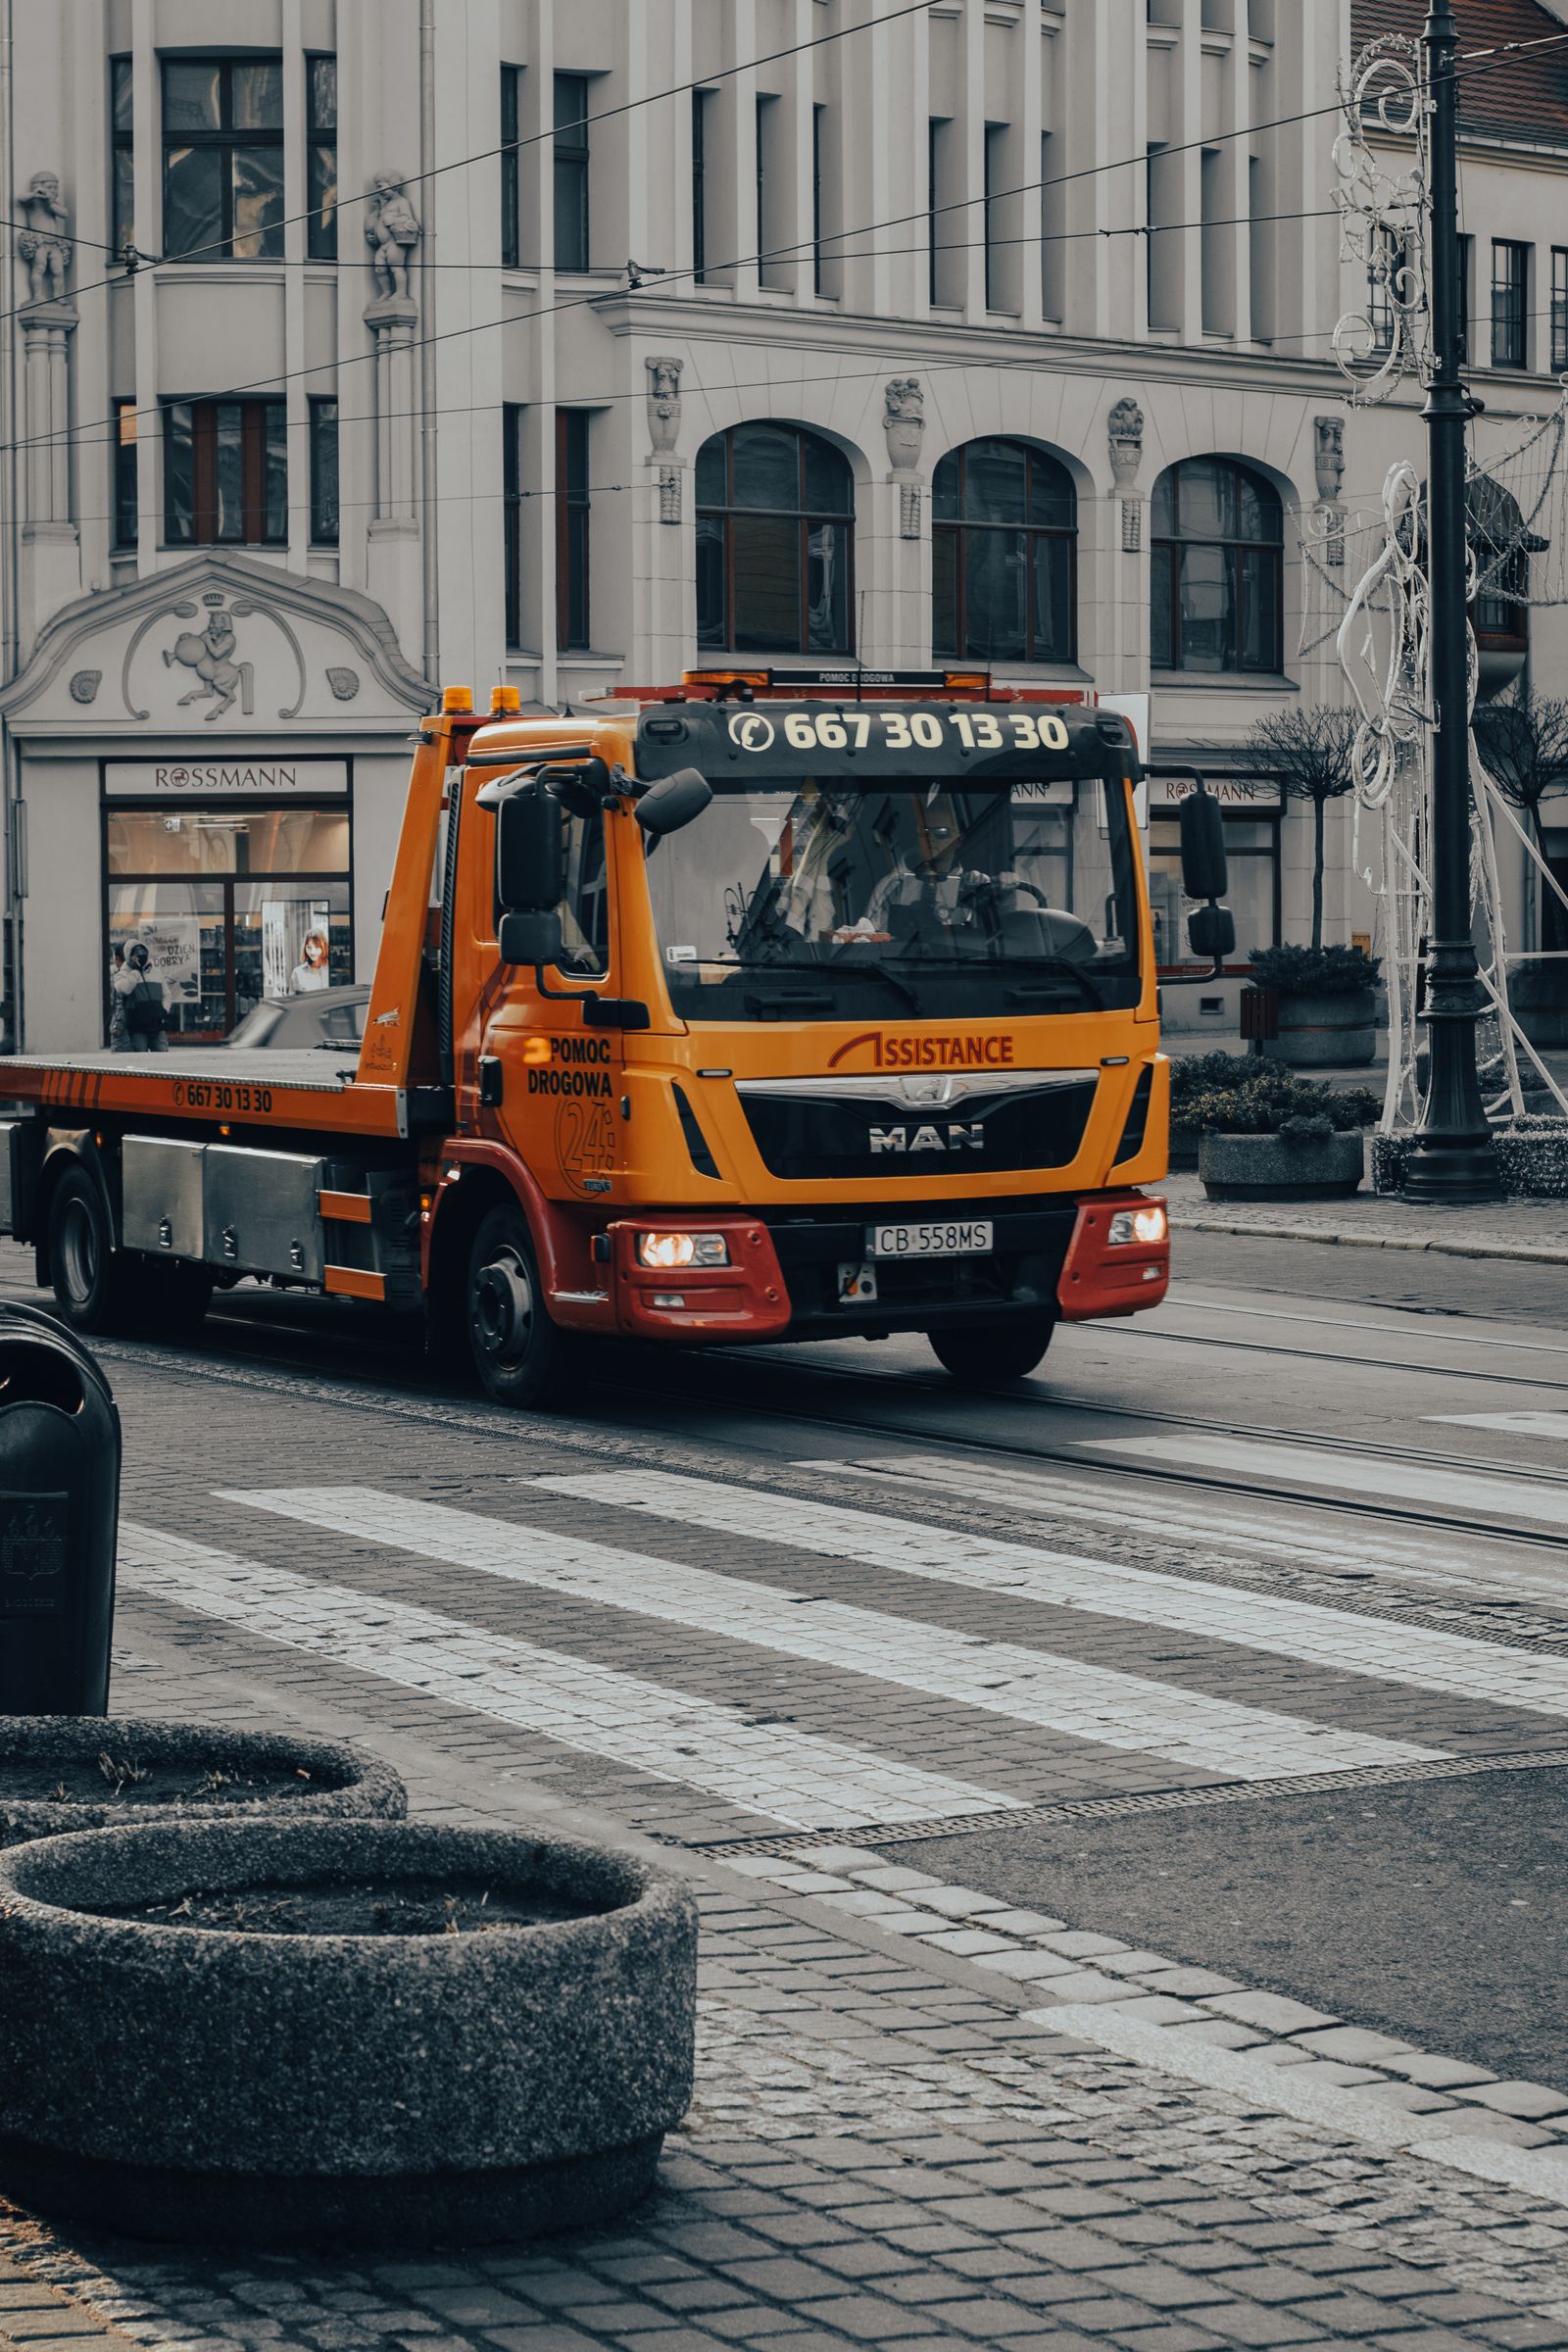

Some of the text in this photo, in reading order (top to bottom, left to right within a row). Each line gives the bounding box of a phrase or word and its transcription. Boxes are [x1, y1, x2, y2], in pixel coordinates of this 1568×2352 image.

[819, 672, 850, 683] POMOC
[784, 712, 1069, 750] 667 30 13 30
[155, 767, 296, 787] ROSSMANN
[1166, 782, 1254, 801] ROSMANN
[550, 1037, 611, 1064] POMOC
[827, 1031, 1013, 1068] ASSISTANCE
[527, 1068, 612, 1098] DROGOWA
[187, 1084, 272, 1112] 667 30 13 30
[868, 1124, 984, 1152] MAN
[881, 1224, 987, 1252] CB 558MS
